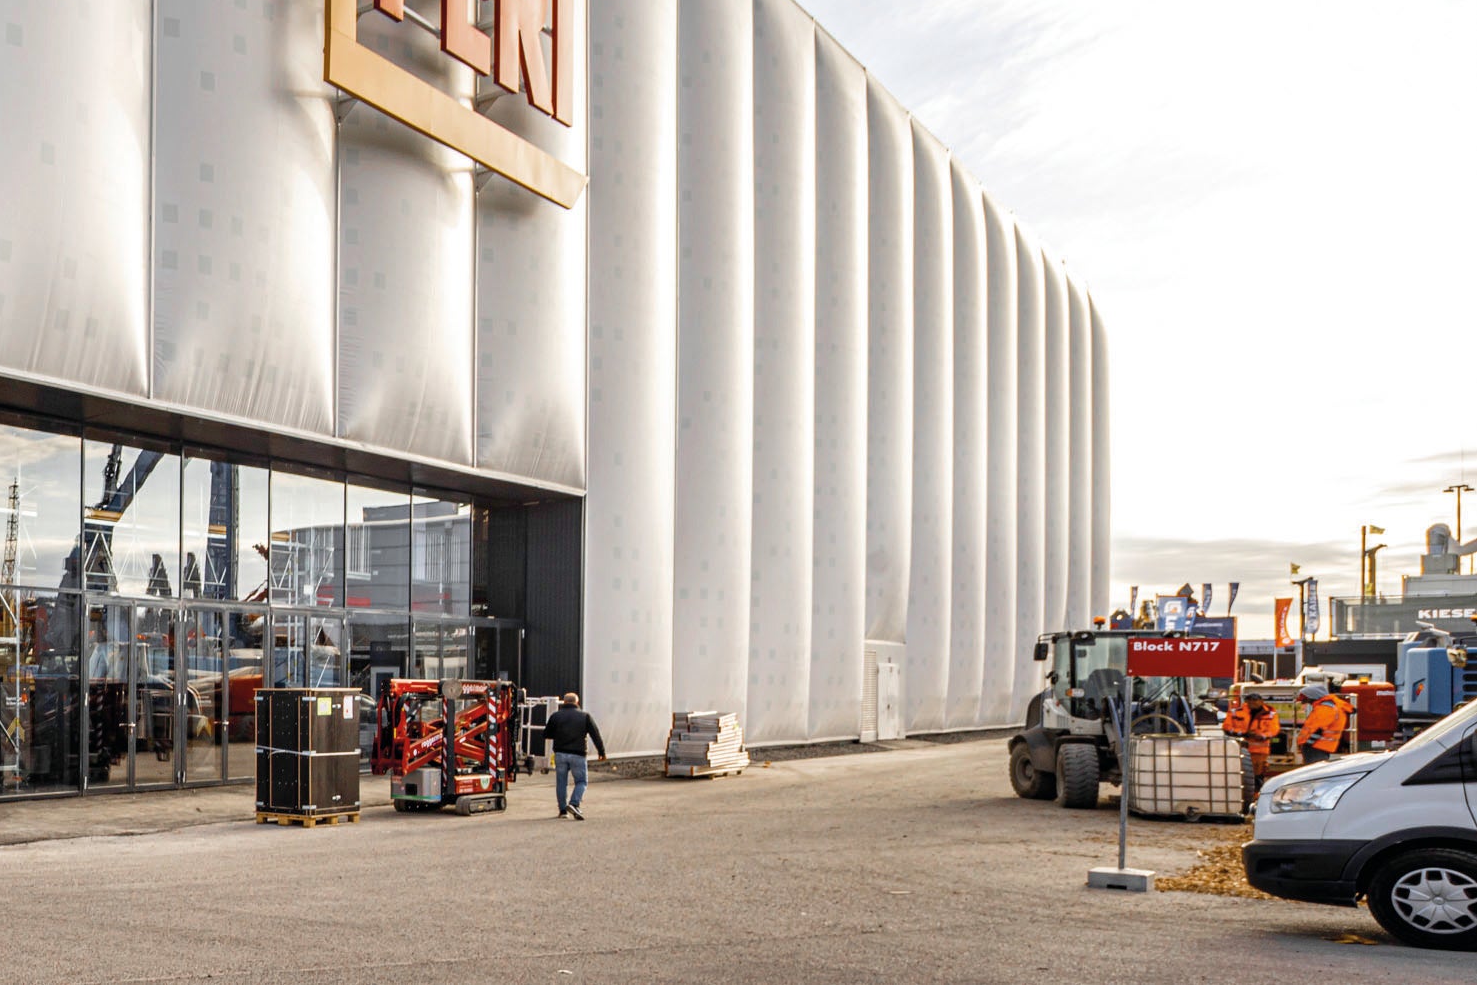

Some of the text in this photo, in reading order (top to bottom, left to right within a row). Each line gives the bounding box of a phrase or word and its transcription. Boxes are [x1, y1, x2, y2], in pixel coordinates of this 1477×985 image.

[1418, 608, 1476, 619] KIESE
[1133, 642, 1220, 652] Block N717
